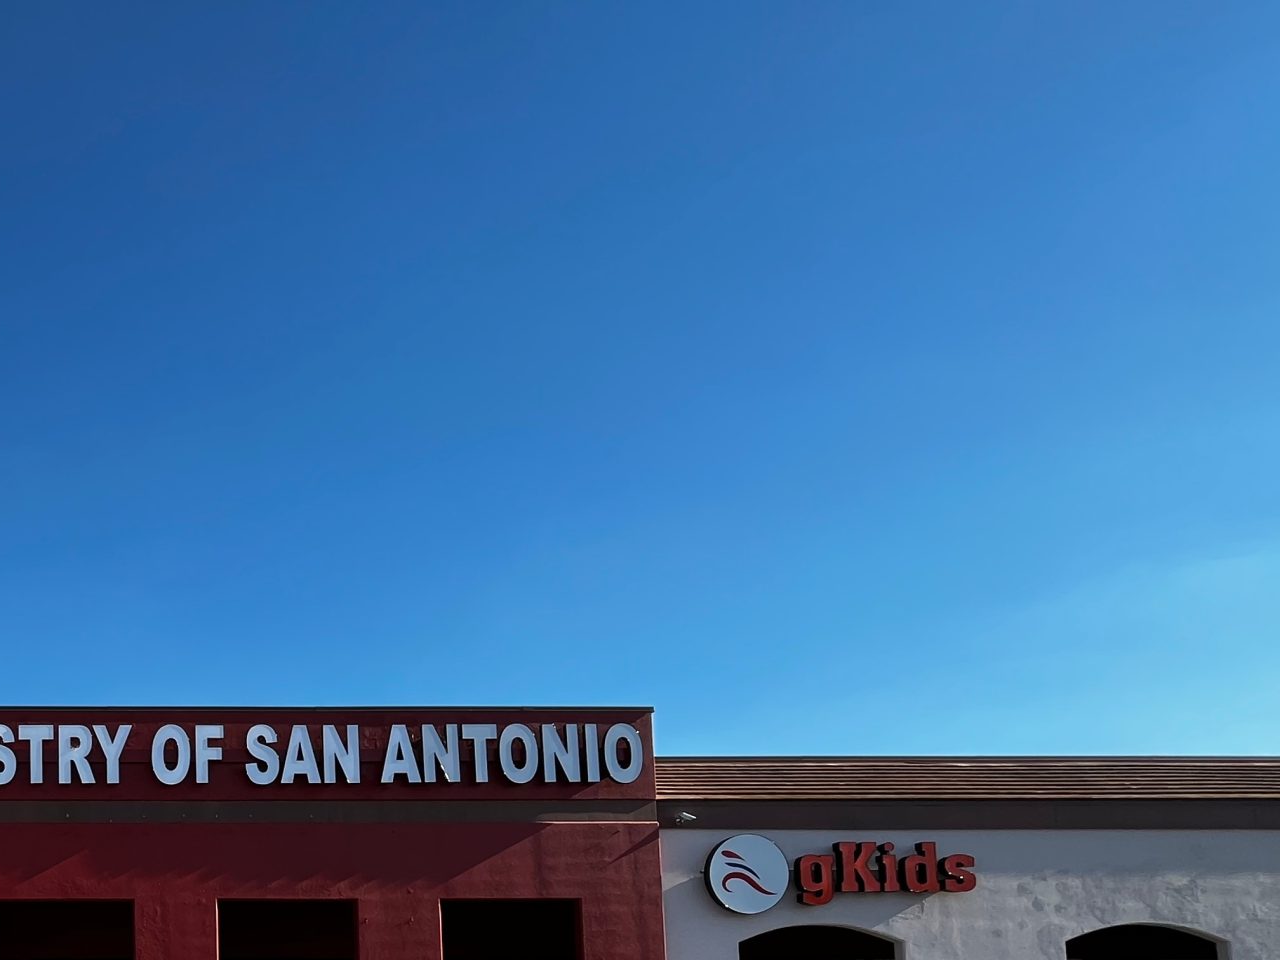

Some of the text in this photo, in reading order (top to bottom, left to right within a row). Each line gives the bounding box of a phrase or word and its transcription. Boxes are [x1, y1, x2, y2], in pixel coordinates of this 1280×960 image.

[151, 724, 224, 785] OF
[245, 724, 361, 785] SAN
[381, 723, 644, 784] ANTONIO
[797, 841, 976, 906] gKids
